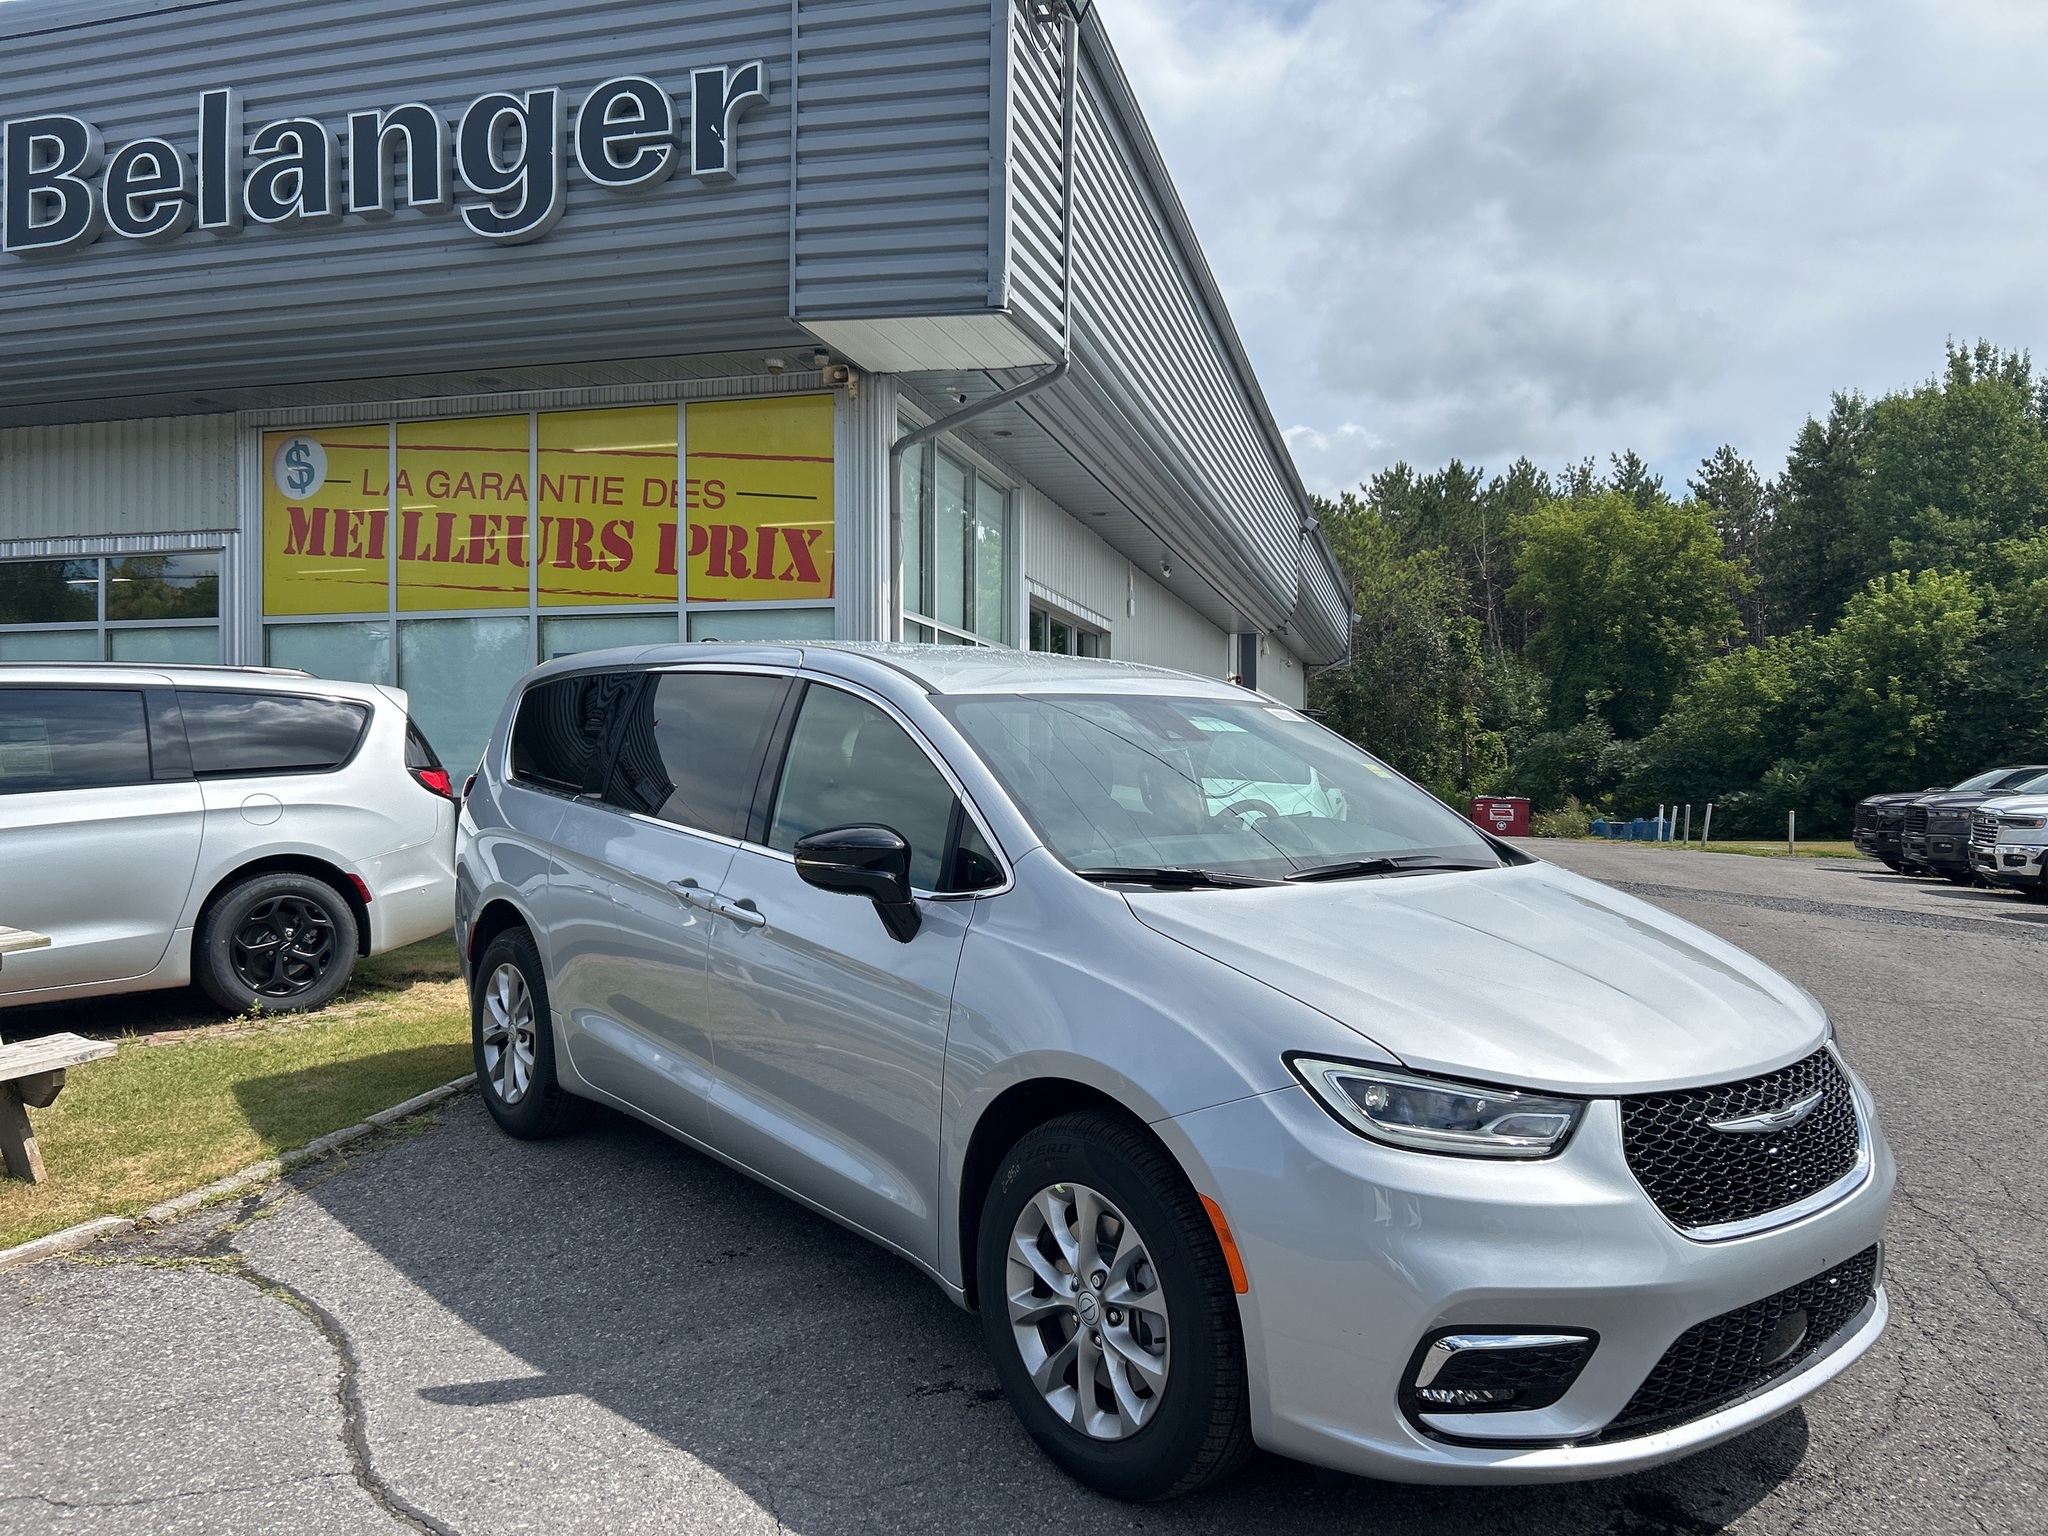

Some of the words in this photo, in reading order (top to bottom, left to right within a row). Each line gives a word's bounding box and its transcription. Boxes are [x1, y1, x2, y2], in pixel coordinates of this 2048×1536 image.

[2, 59, 768, 253] Belanger
[362, 468, 414, 496] LA
[425, 470, 625, 505] GARANTIE
[641, 478, 726, 509] DES
[284, 506, 634, 573] MEILLEURS
[655, 522, 822, 583] PRIX
